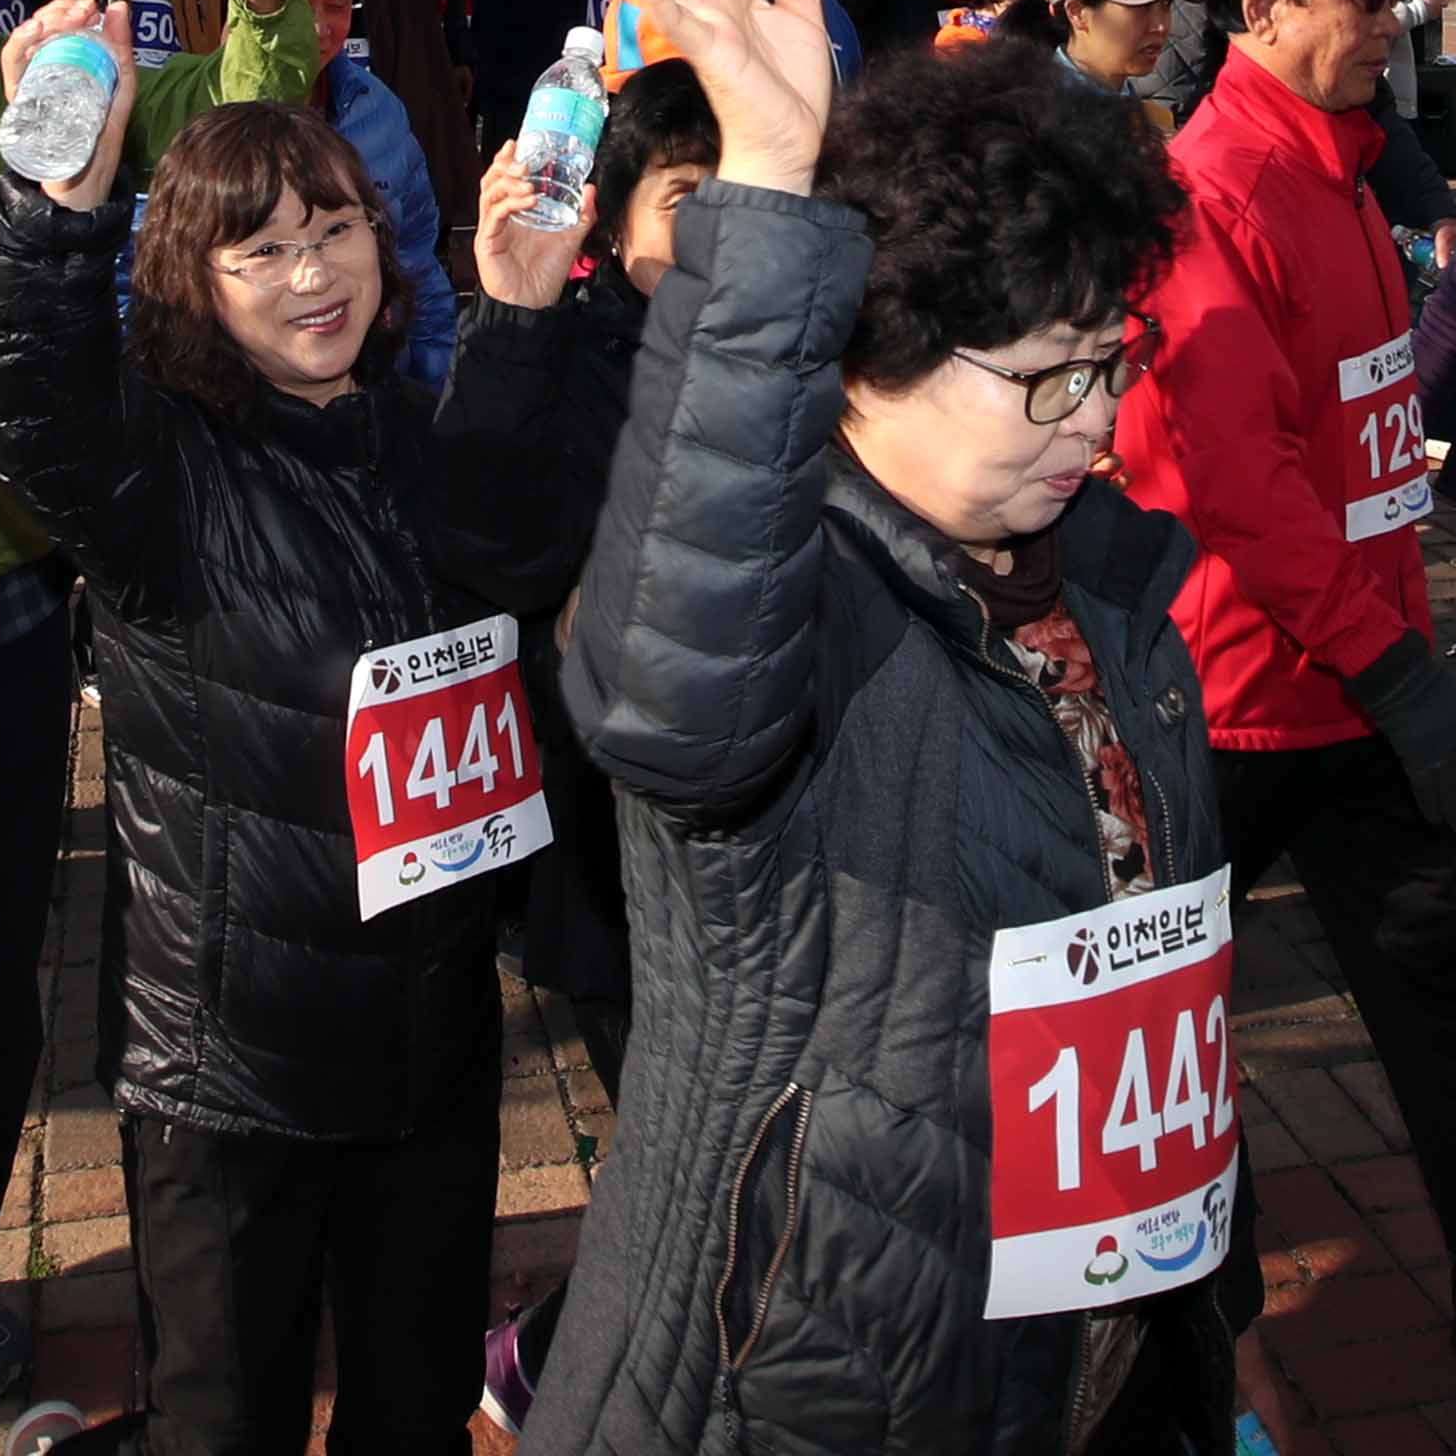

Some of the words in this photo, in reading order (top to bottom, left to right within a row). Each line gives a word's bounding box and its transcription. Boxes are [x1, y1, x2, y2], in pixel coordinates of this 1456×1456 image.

[1359, 393, 1425, 480] 129
[407, 631, 496, 684] 인천일보
[358, 691, 524, 827] 1441
[1105, 901, 1209, 972] 인천일보
[1028, 994, 1234, 1192] 1442
